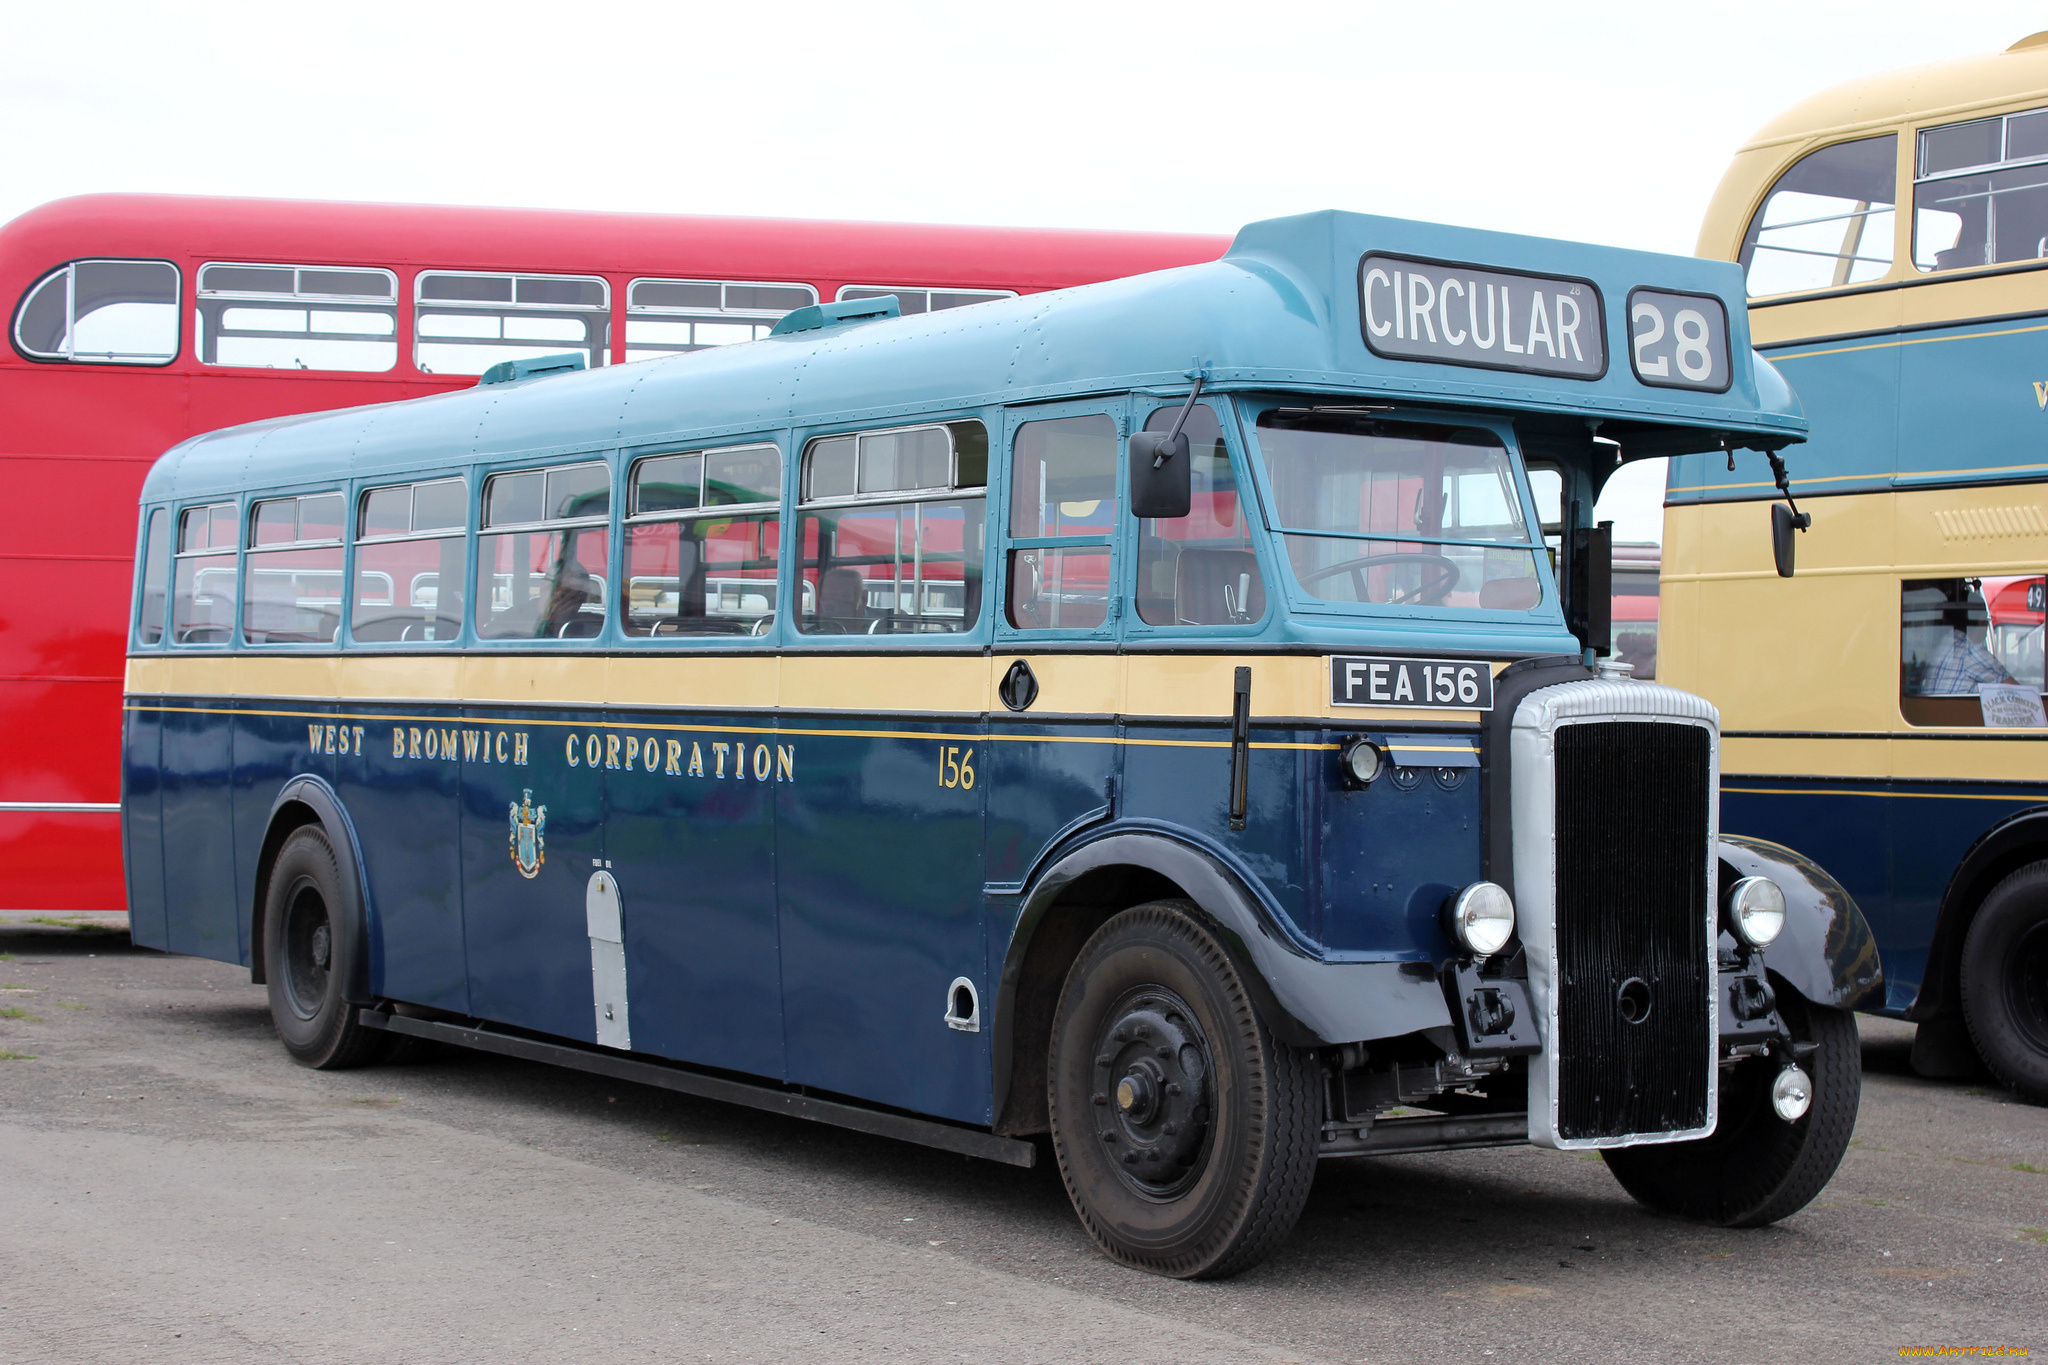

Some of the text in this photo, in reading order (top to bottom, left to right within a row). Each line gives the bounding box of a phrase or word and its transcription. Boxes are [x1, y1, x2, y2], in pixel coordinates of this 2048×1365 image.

[1569, 284, 1581, 296] 28
[1364, 268, 1584, 362] CIRCULAR
[1631, 302, 1712, 381] 28
[1346, 663, 1478, 703] FEA 156
[308, 724, 796, 783] WEST BROMWICH CORPORATION
[939, 746, 975, 790] 156
[592, 858, 602, 867] FUEL
